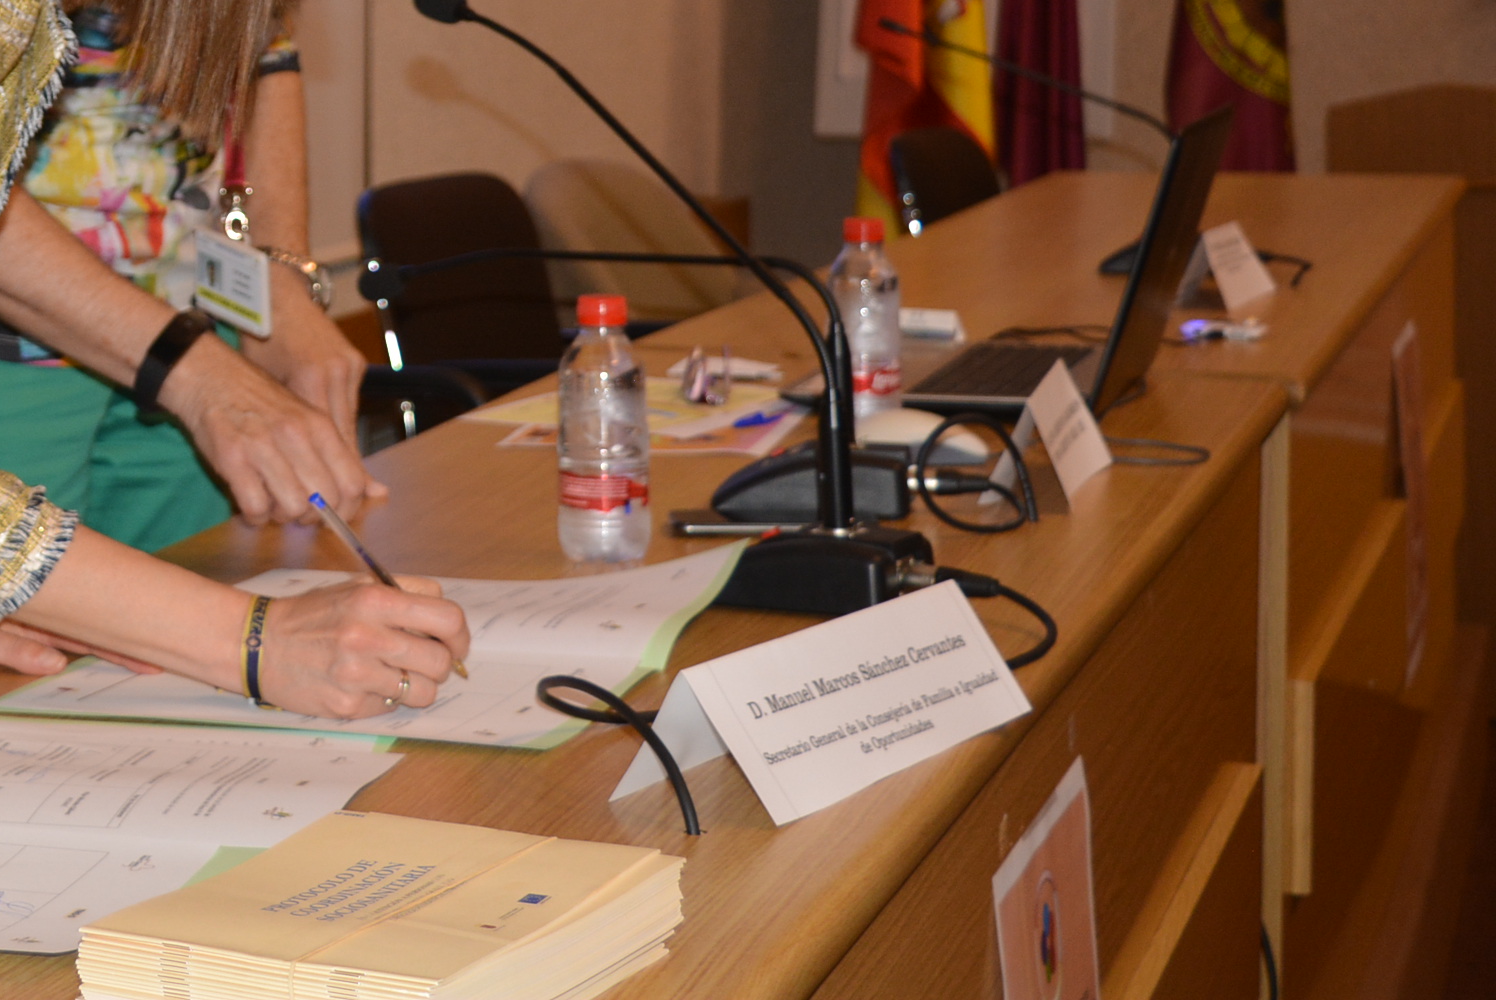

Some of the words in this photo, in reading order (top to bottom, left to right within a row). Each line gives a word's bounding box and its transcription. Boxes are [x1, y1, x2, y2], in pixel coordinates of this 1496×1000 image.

[747, 701, 768, 719] D.
[764, 683, 816, 713] Manuel
[812, 678, 861, 697] Marcos
[858, 655, 910, 681] Sánchez
[907, 634, 966, 663] Cervantes
[763, 740, 812, 765] Secretario
[809, 725, 847, 748] General
[846, 722, 859, 736] de
[854, 719, 869, 731] la
[911, 698, 924, 711] de
[920, 687, 956, 707] Familia
[954, 685, 962, 696] e
[958, 668, 1000, 695] Igualdad
[860, 740, 874, 754] de
[870, 719, 935, 751] Oportunidades
[261, 864, 355, 913] PROTOCOLO
[352, 859, 379, 874] DE
[289, 861, 406, 917] COORDINACIÓN
[315, 864, 437, 922] SOCIOSANITARIA
